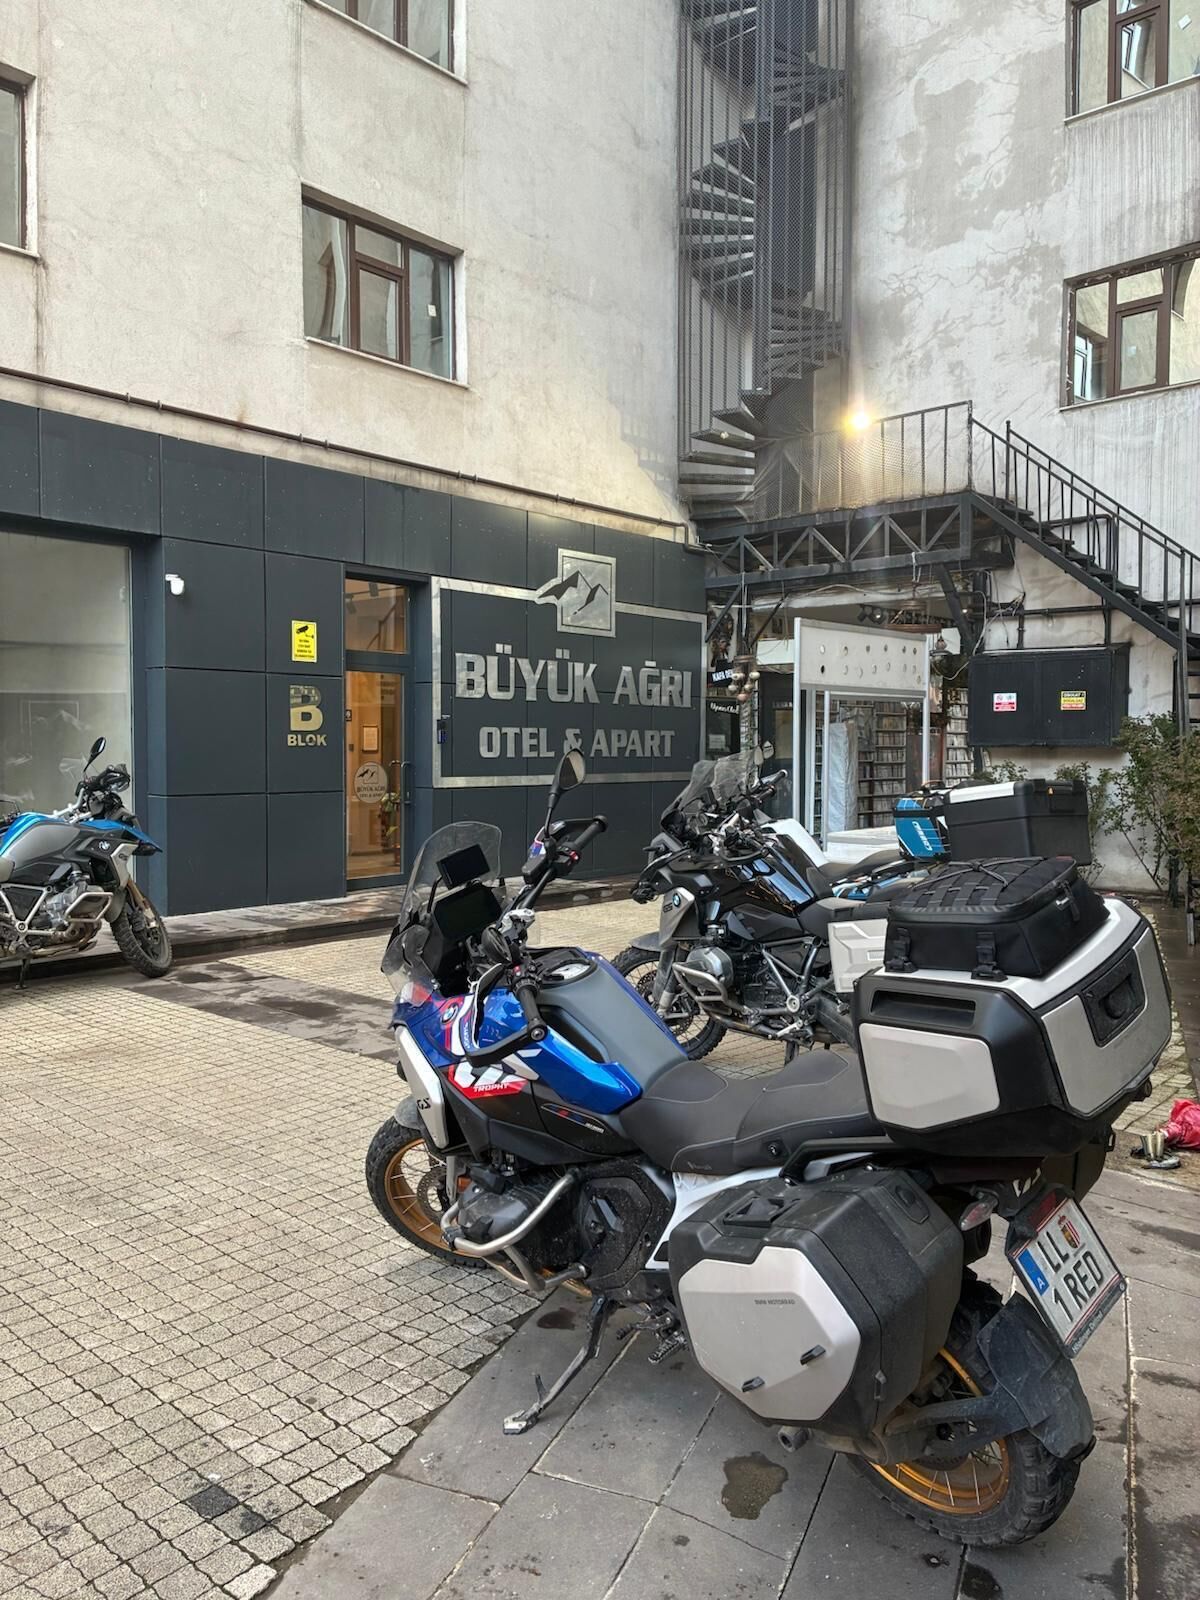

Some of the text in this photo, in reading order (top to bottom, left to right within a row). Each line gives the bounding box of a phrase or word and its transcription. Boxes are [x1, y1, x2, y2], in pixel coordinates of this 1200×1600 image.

[455, 643, 693, 708] BÜYÜK AĞRI
[289, 685, 323, 731] B
[287, 734, 327, 747] BLOK
[479, 727, 555, 758] OTEL
[563, 728, 583, 755] &
[590, 729, 675, 758] APART
[473, 1083, 509, 1093] TROPHY
[416, 1098, 431, 1110] GS
[1037, 1231, 1070, 1272] LL
[1036, 1278, 1046, 1290] A
[1052, 1250, 1105, 1323] 1 RED
